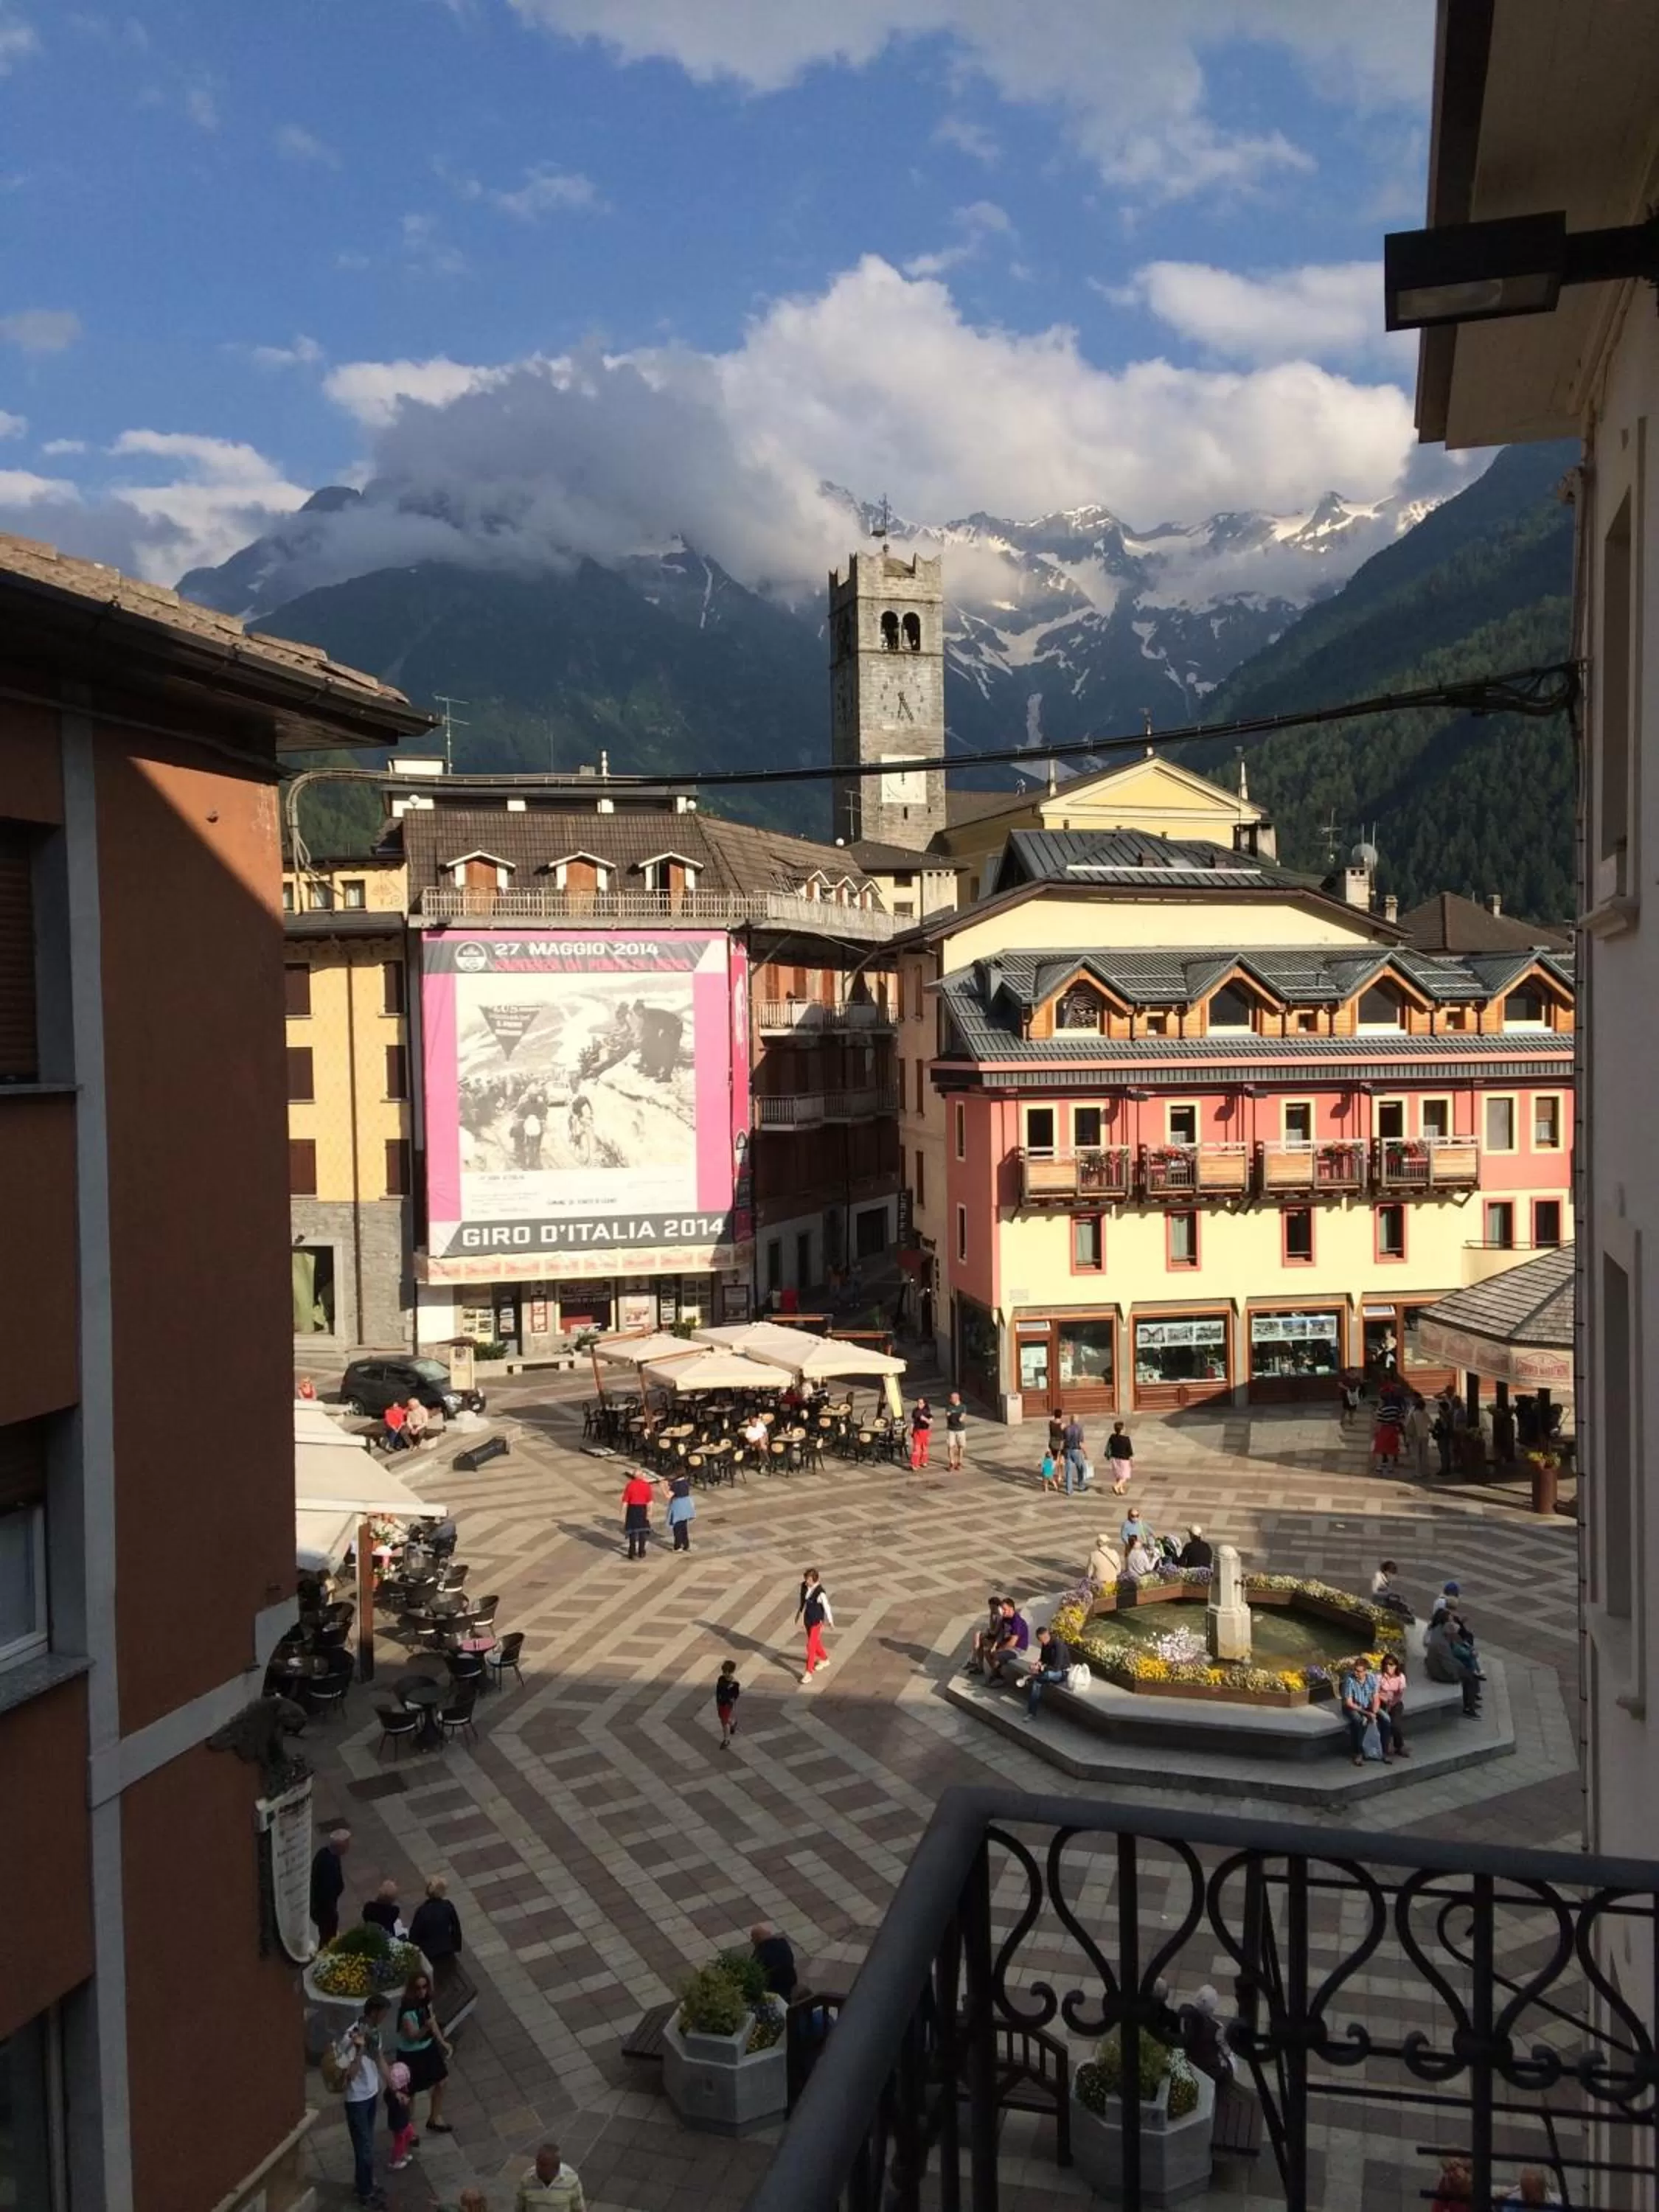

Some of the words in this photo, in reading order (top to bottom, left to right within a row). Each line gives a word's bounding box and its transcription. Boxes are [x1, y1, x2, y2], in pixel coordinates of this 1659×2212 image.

[495, 943, 521, 956] 27
[529, 943, 605, 956] MAGGIO
[613, 943, 658, 956] 2014
[462, 1226, 531, 1247] GIRO
[540, 1220, 655, 1243] D'ITALIA
[664, 1217, 726, 1238] 2014
